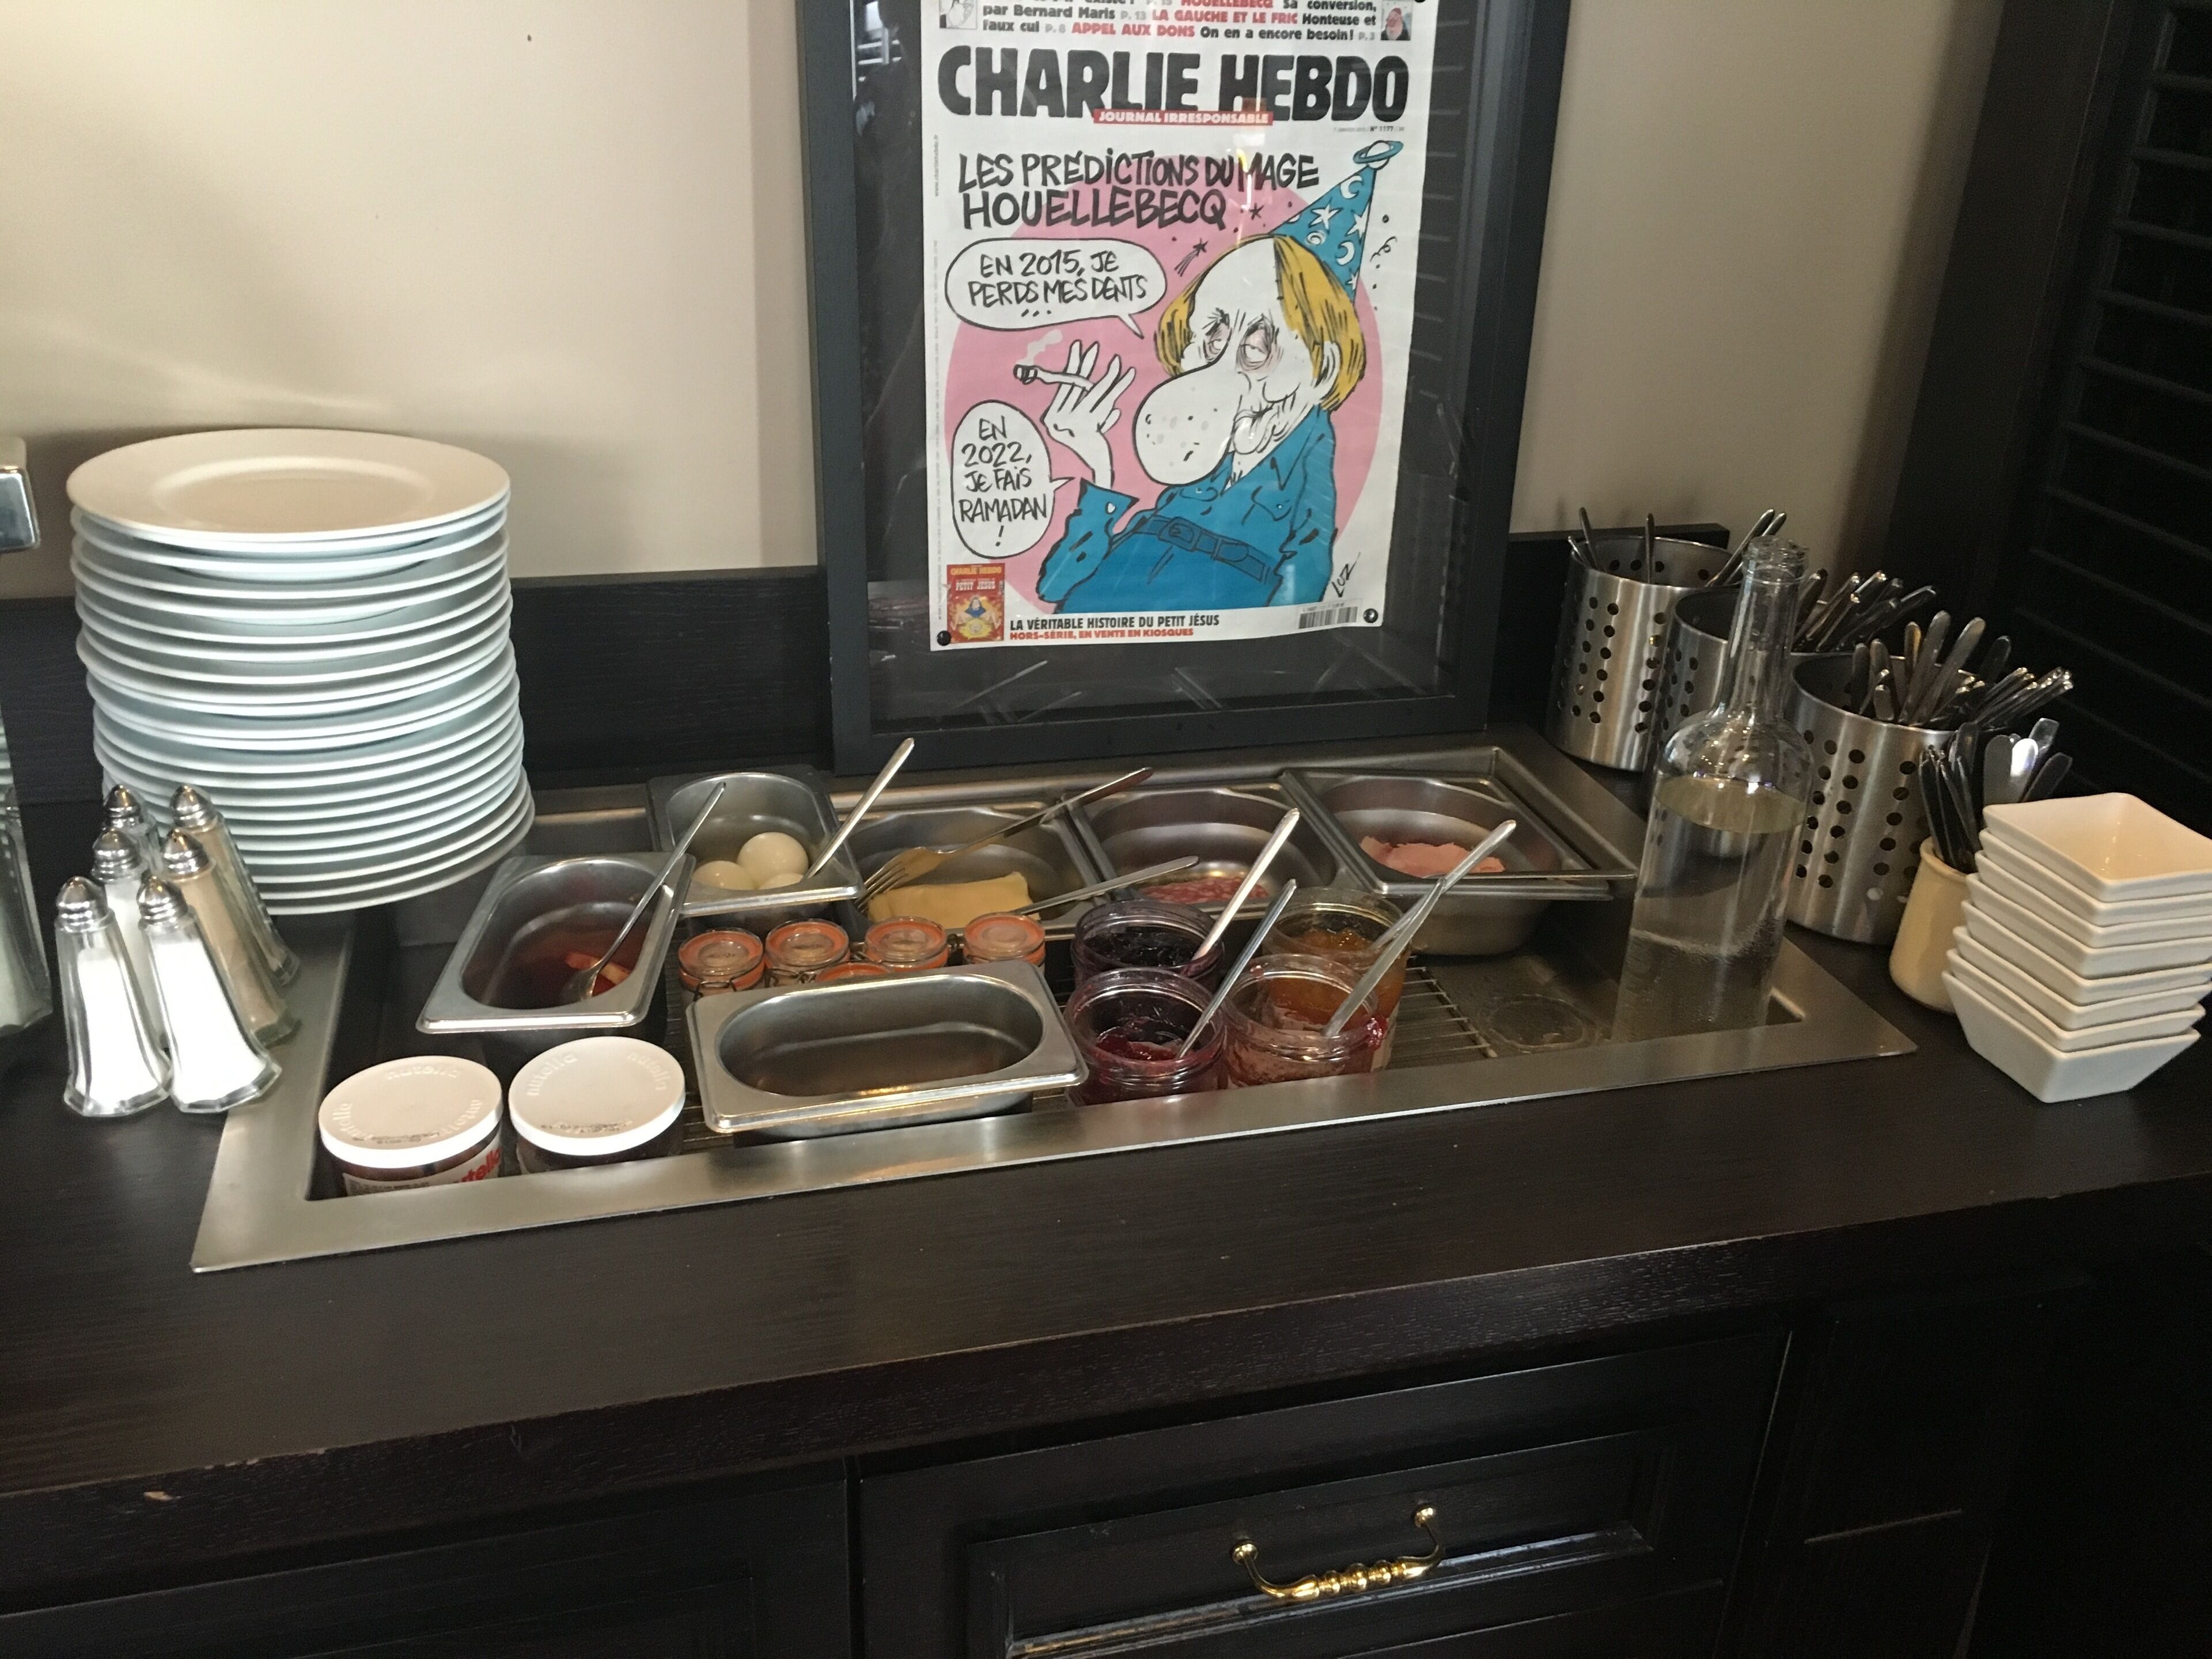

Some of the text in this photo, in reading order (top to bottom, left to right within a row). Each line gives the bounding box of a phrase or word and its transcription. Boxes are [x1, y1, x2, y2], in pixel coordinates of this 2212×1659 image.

[983, 5, 1008, 16] par
[1014, 4, 1073, 18] Bernard
[1078, 6, 1115, 19] Maris
[1152, 10, 1169, 21] LA
[1175, 10, 1229, 22] GAUCHE
[1233, 12, 1248, 23] ET
[1252, 12, 1266, 24] LE
[1271, 13, 1298, 24] FRIC
[1302, 14, 1359, 25] Honteuse
[1364, 14, 1376, 25] et
[1306, 0, 1377, 12] conversion,
[983, 19, 1014, 31] faux
[1020, 21, 1040, 32] cul
[1072, 22, 1116, 35] APPEL
[1122, 24, 1151, 36] AUX
[1157, 25, 1195, 37] DONS
[1200, 26, 1219, 38] On
[1224, 28, 1240, 39] en
[1245, 29, 1253, 39] a
[1259, 29, 1302, 40] encore
[937, 44, 1410, 122] CHARLIE HEBDO
[1099, 111, 1268, 124] JOURNAL IRRESPONSABLE
[959, 147, 1320, 193] LES PRÉDICTIONS DU MAGE
[963, 184, 1227, 230] HOUELLEBECQ
[980, 249, 1119, 278] EN 2015, JE
[967, 274, 1148, 308] PERDS MES DENTS
[978, 415, 1007, 441] EN
[961, 441, 1033, 468] 2022,
[964, 466, 1032, 493] JE FAIS
[958, 494, 1048, 523] RAMADAN
[1010, 613, 1220, 631] LA VÉRITABLE HISTOIRE DU PETIT JÉSUS
[1010, 627, 1194, 640] HORS-SÉRIE, EN VENTE EN KIOSQUES
